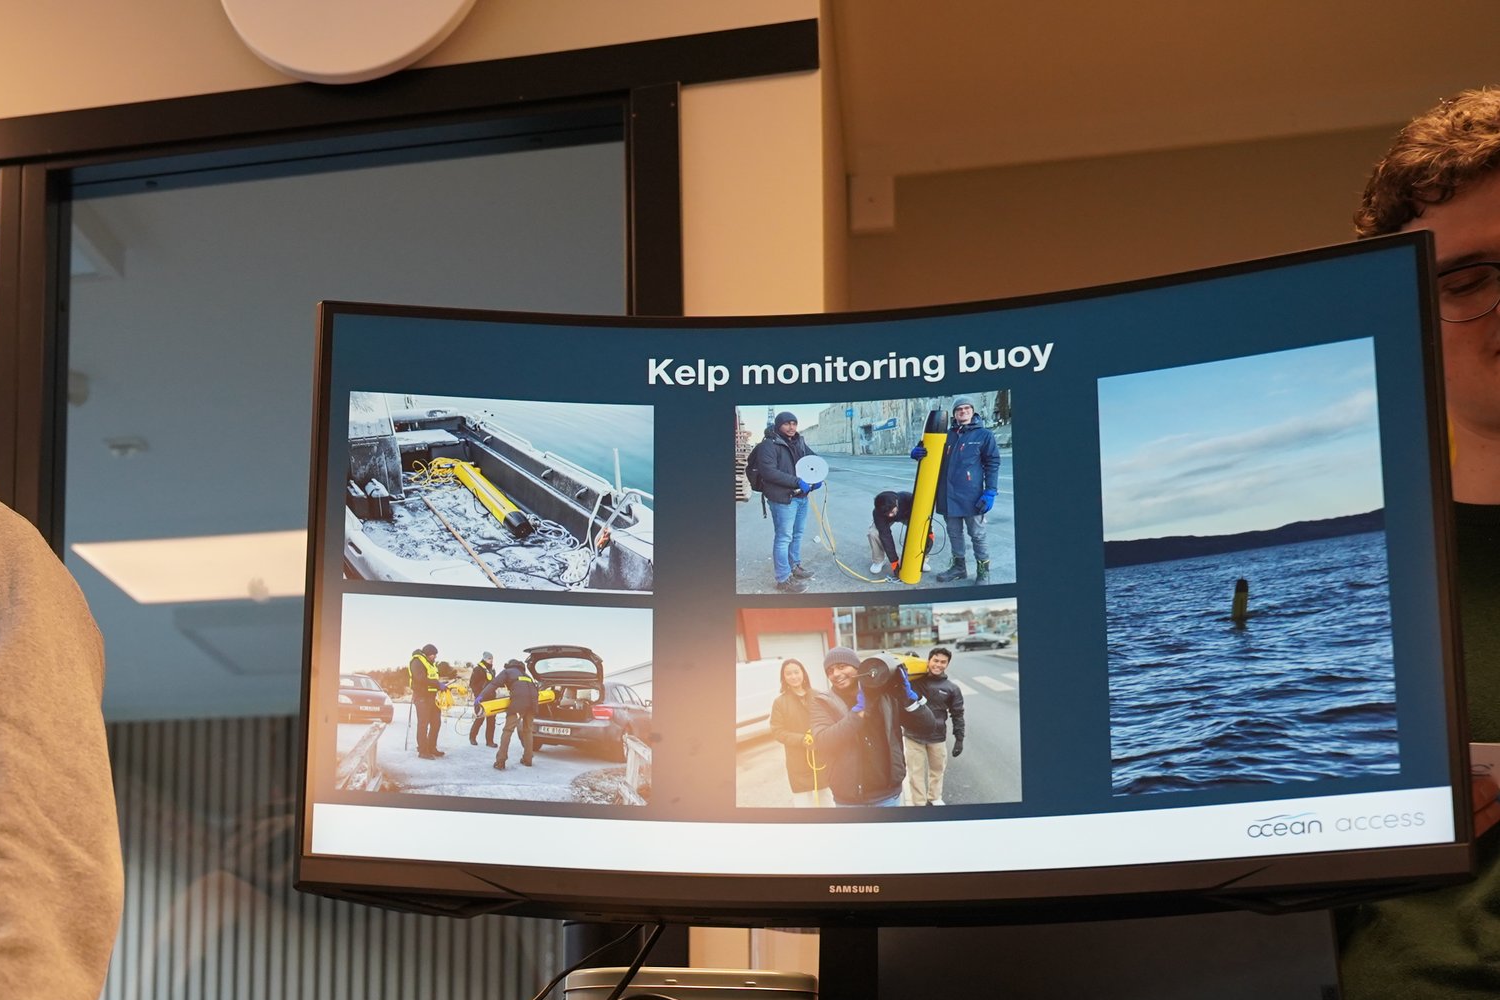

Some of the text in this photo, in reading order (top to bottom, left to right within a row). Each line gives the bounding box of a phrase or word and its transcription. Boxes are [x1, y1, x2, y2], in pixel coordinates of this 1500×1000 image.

[648, 342, 1054, 392] Kelp monitoring buoy
[1247, 801, 1426, 838] ocean access
[829, 885, 880, 894] SAMSUNG
